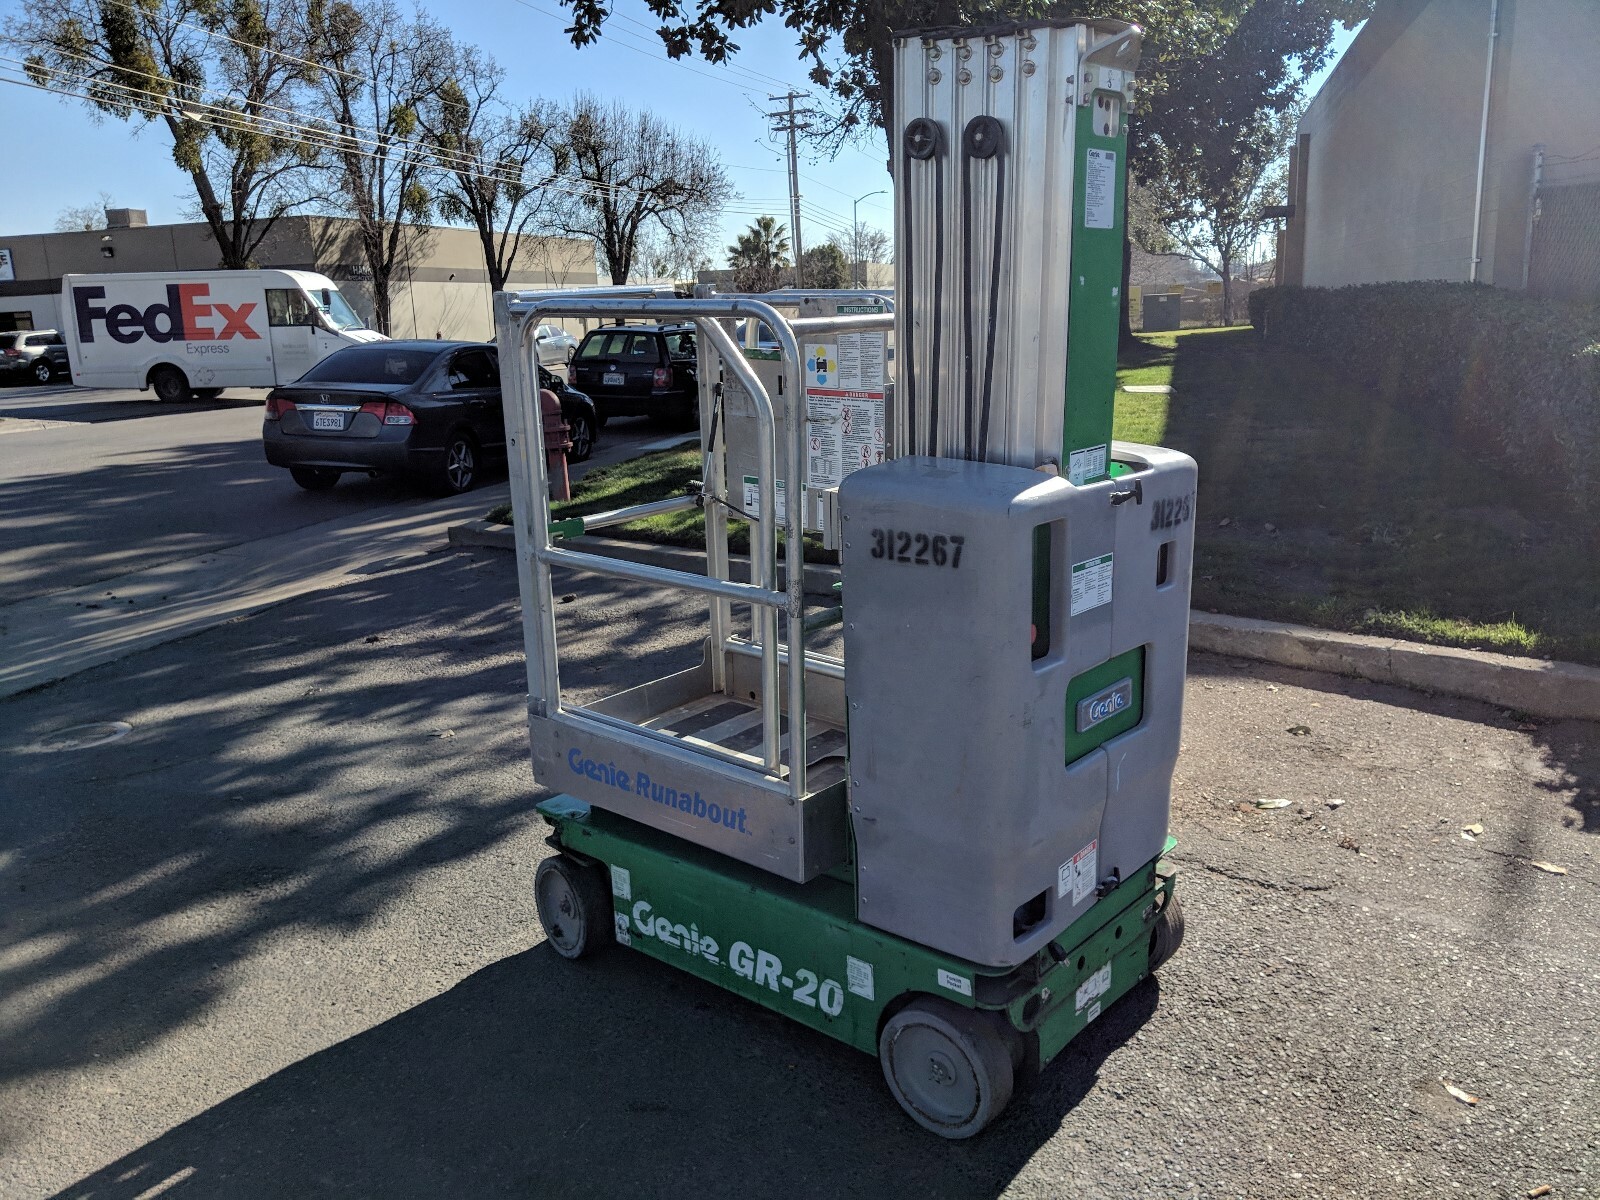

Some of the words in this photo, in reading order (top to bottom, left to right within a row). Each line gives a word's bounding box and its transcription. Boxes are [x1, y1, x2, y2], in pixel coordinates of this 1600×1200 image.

[72, 283, 262, 344] FedEx
[186, 343, 230, 356] Express
[870, 528, 965, 569] 312267
[1090, 692, 1124, 721] Genie
[567, 747, 630, 792] Genie
[636, 771, 748, 834] Runabout
[632, 900, 720, 966] Genie
[728, 940, 844, 1017] GR-20
